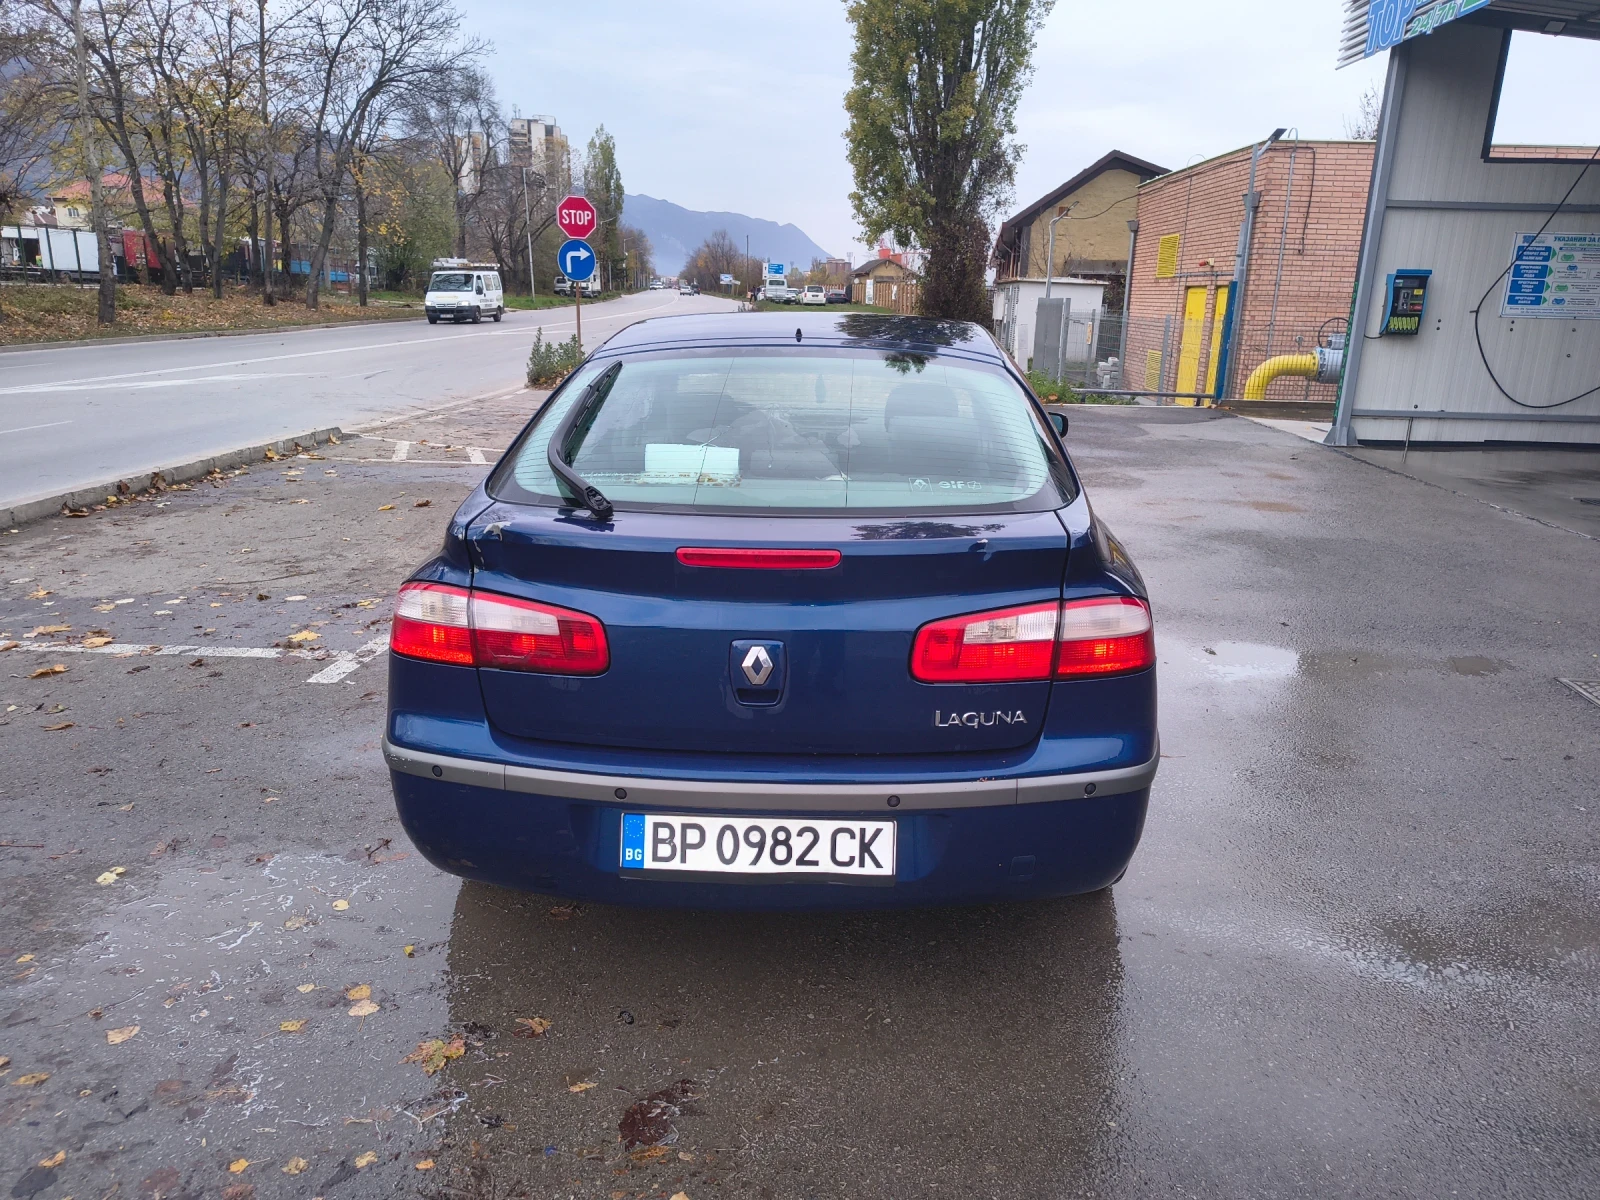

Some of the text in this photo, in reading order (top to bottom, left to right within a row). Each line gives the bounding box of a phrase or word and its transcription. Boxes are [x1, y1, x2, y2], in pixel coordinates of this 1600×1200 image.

[1366, 0, 1416, 54] TOP
[562, 209, 592, 226] STOP
[934, 710, 1028, 729] LAGUNA
[624, 847, 643, 861] BG
[652, 821, 884, 869] BP 0982 CK
